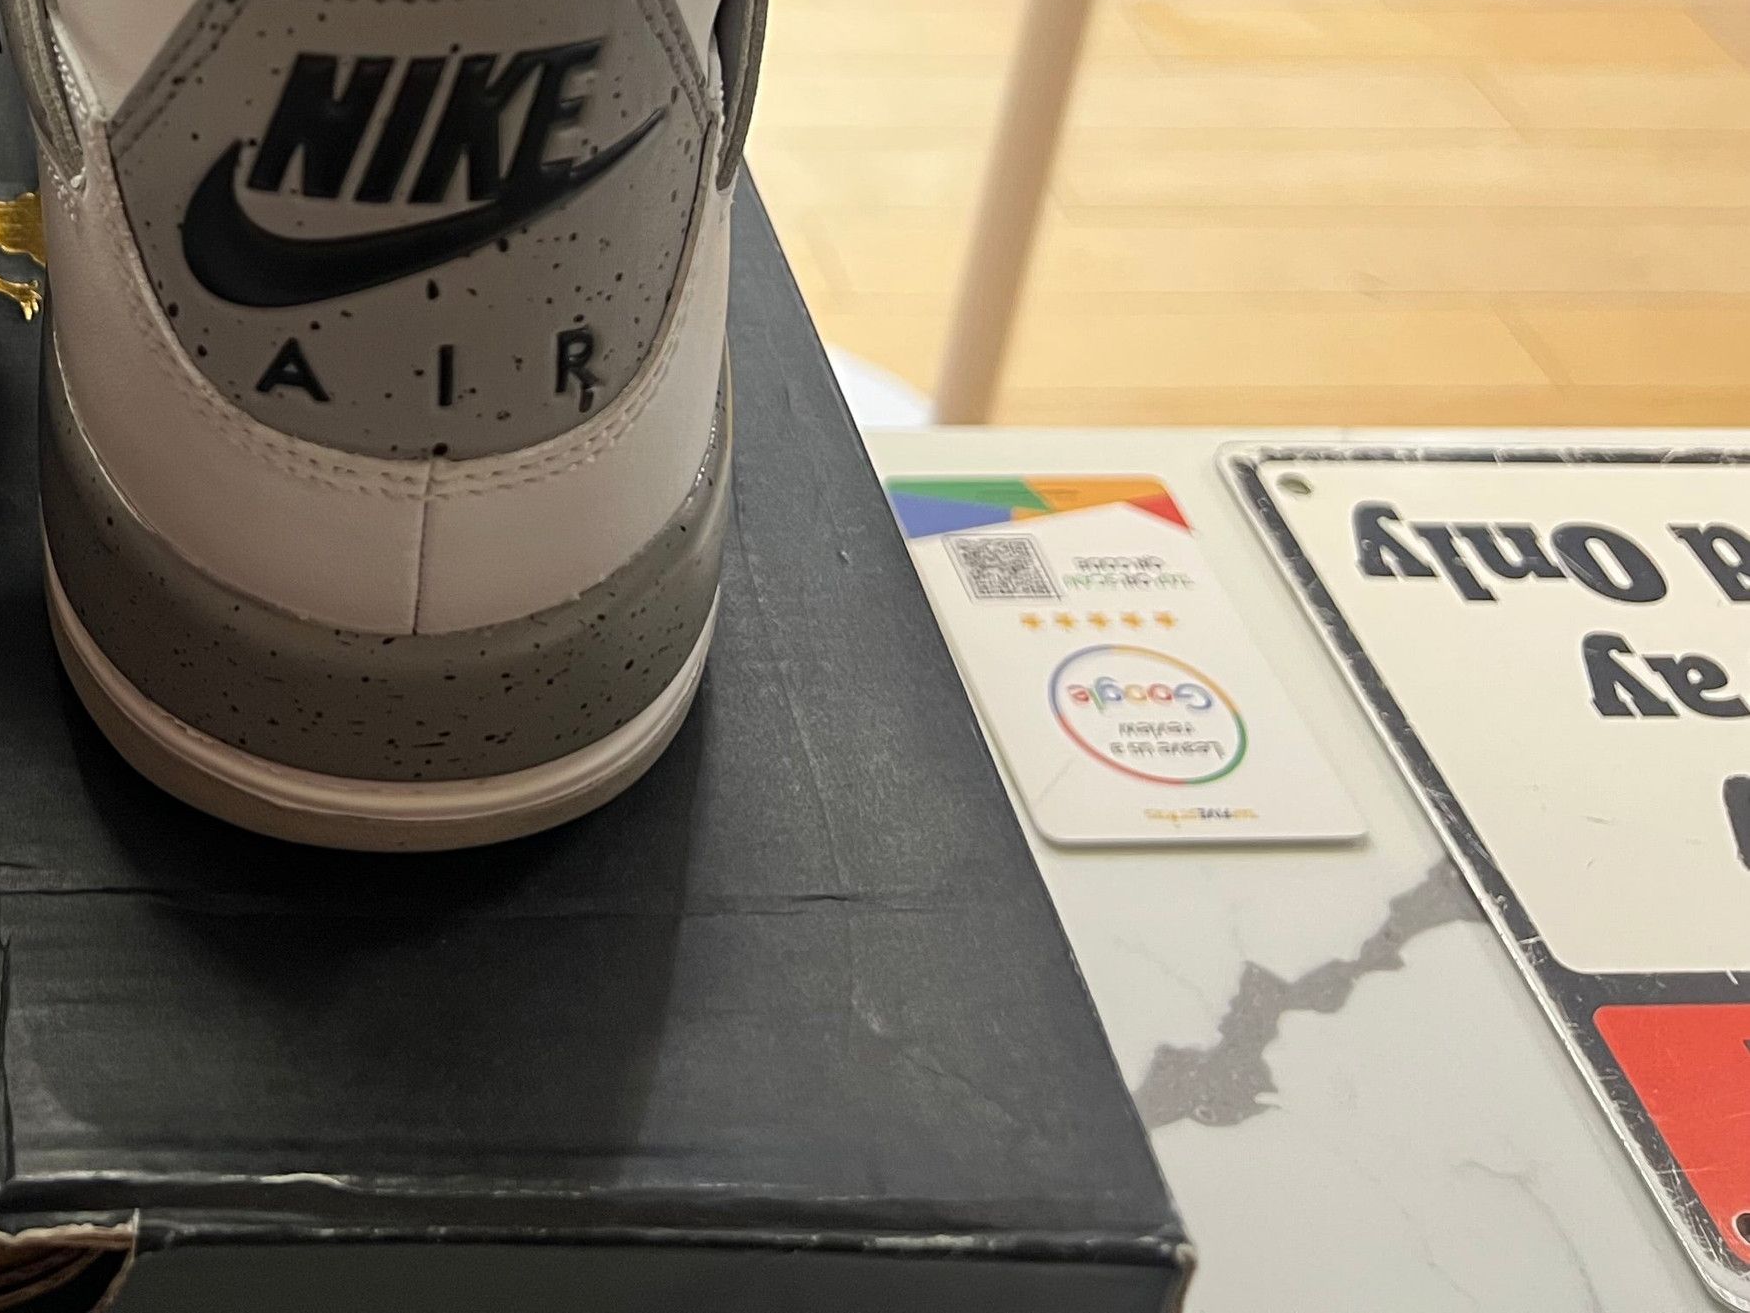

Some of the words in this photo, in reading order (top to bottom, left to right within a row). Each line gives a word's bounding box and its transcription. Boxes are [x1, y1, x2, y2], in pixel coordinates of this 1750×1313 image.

[246, 36, 607, 204] NIKE
[255, 326, 608, 407] AIR
[1353, 503, 1668, 603] Only
[1066, 675, 1214, 715] Google
